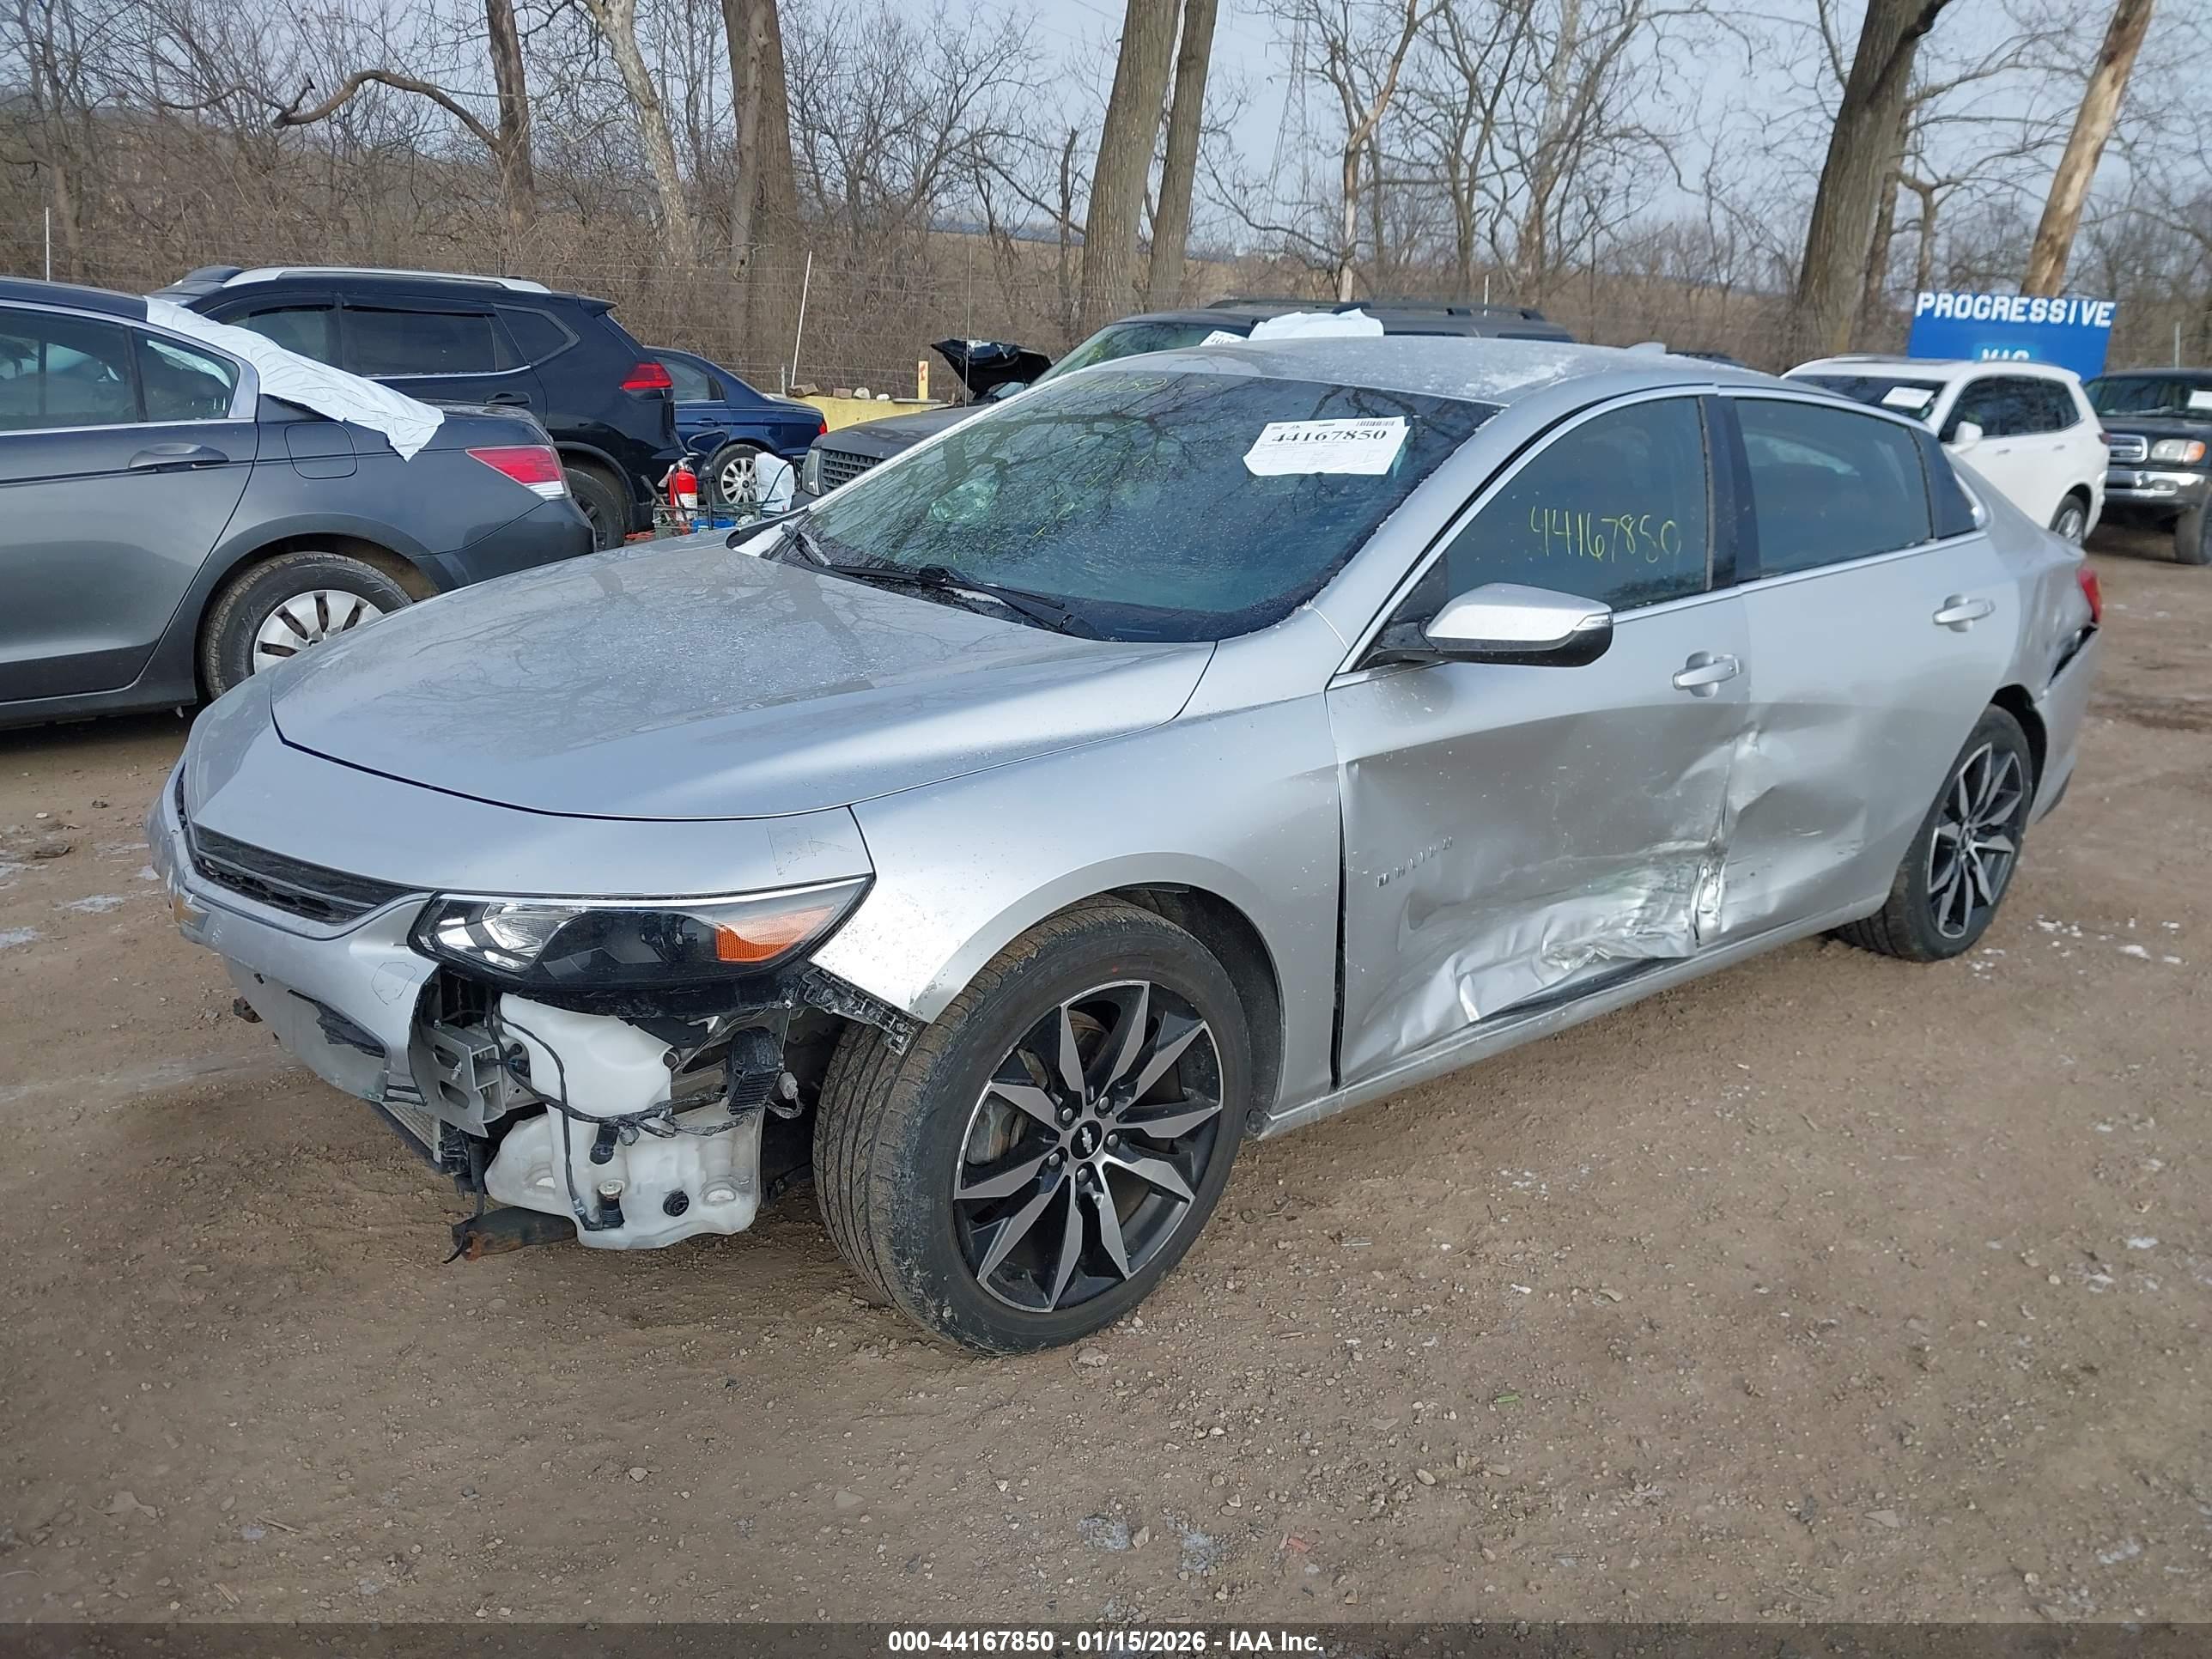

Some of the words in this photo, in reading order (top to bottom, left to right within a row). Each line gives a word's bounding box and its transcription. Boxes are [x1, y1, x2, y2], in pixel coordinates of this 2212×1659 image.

[1915, 291, 2116, 328] PROGRESSIVE
[1272, 429, 1388, 443] 44167850
[1529, 506, 1682, 563] 44167850
